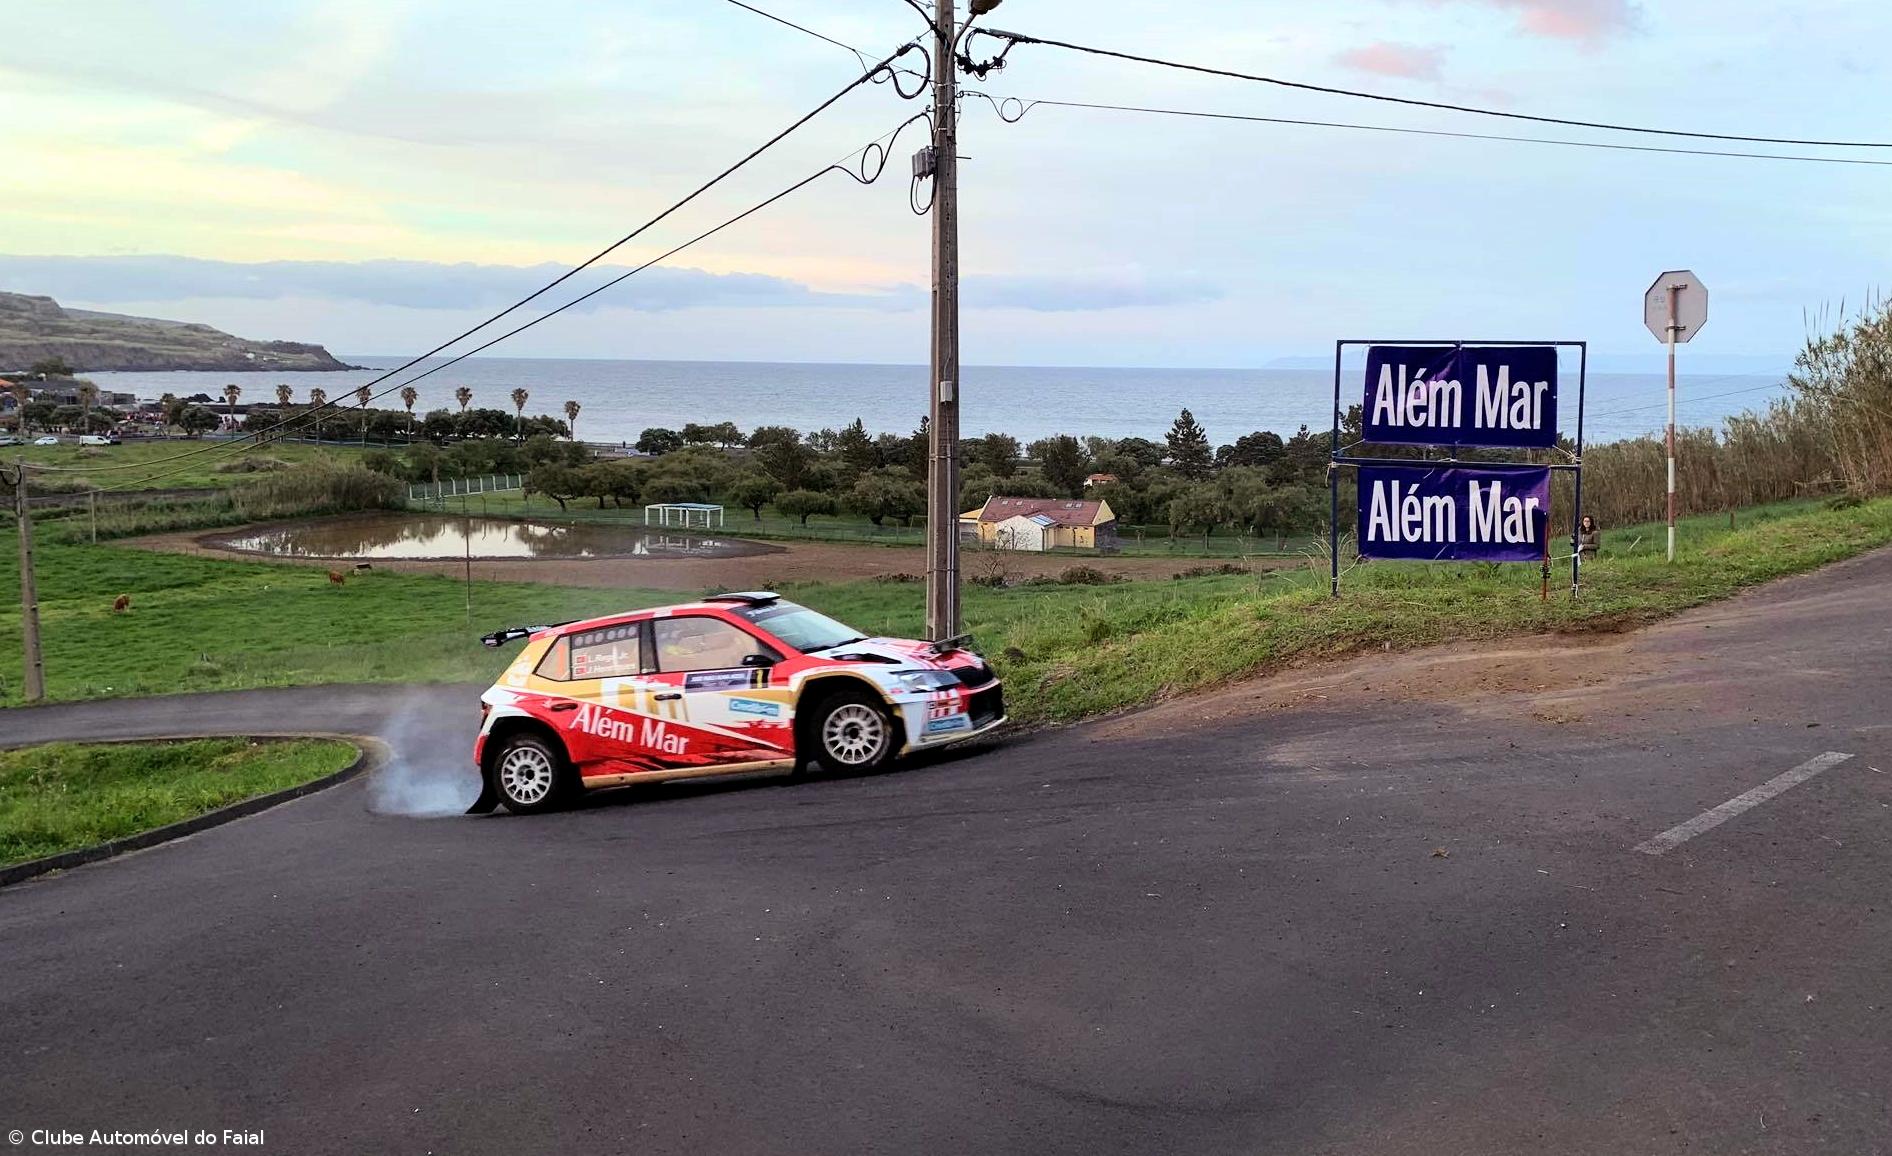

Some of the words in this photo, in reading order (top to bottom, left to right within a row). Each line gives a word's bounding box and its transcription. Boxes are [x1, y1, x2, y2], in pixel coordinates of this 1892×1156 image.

[1371, 363, 1462, 427] Além
[1475, 364, 1549, 430] Mar
[1367, 480, 1456, 543] Além
[1469, 480, 1539, 544] Mar
[569, 703, 634, 743] Além
[640, 718, 690, 755] Mar
